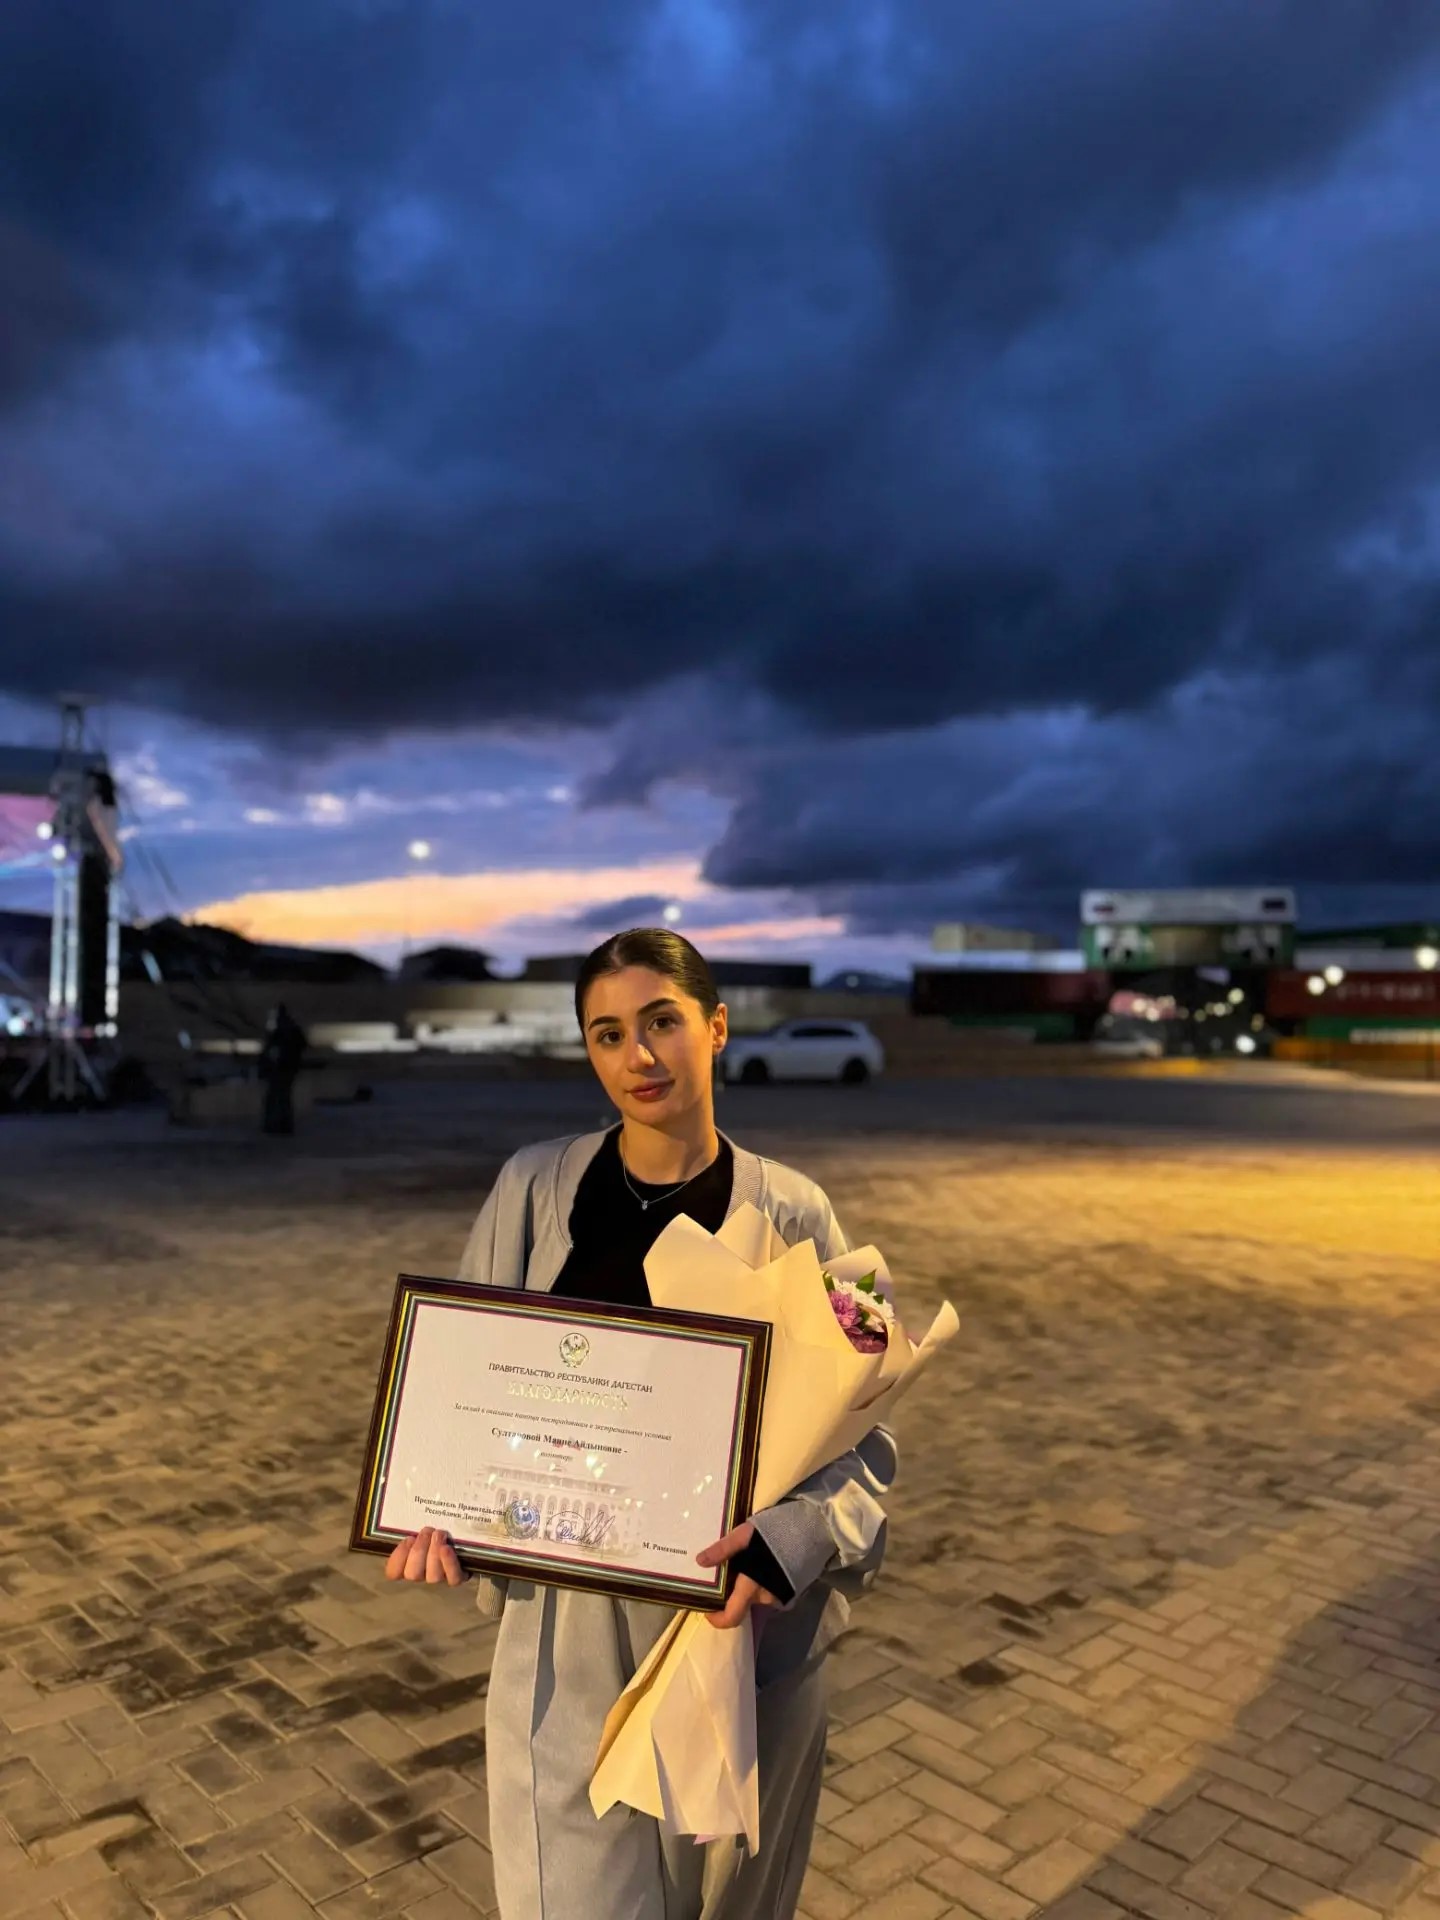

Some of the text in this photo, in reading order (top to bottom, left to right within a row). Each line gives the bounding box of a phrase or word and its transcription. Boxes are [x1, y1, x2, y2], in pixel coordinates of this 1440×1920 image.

[488, 1362, 653, 1393] ПРАВИТЕЛЬСТВО РЕСПУБЛИКИ ДАГЕСТАН
